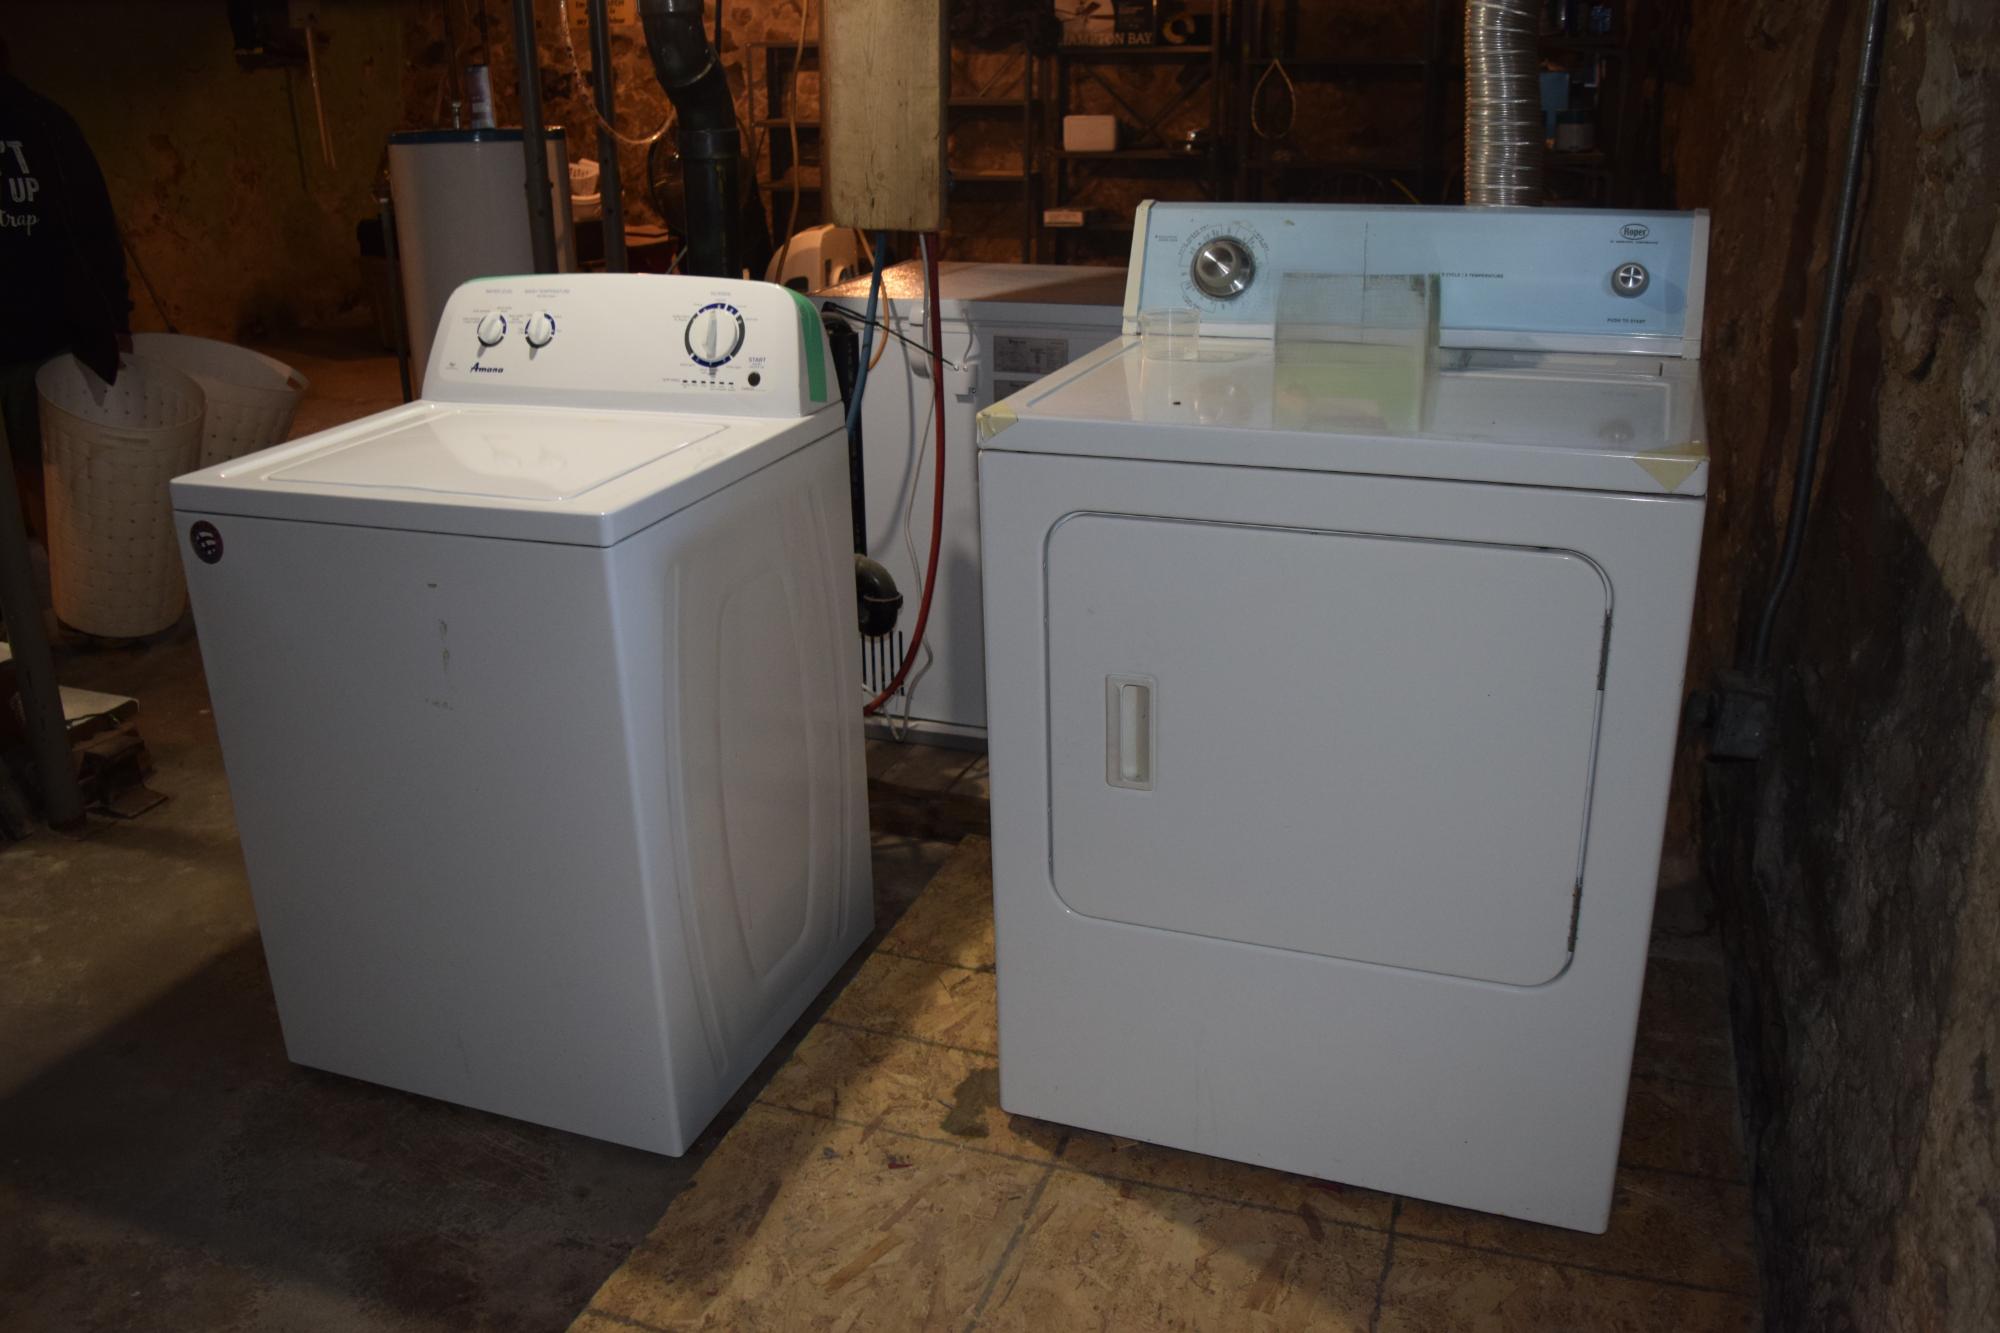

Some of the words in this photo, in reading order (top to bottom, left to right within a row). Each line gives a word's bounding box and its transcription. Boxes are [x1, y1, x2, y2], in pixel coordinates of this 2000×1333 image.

[1127, 32, 1153, 46] BAY
[8, 176, 40, 203] UP
[1623, 224, 1648, 238] Roper
[469, 361, 504, 374] Amana
